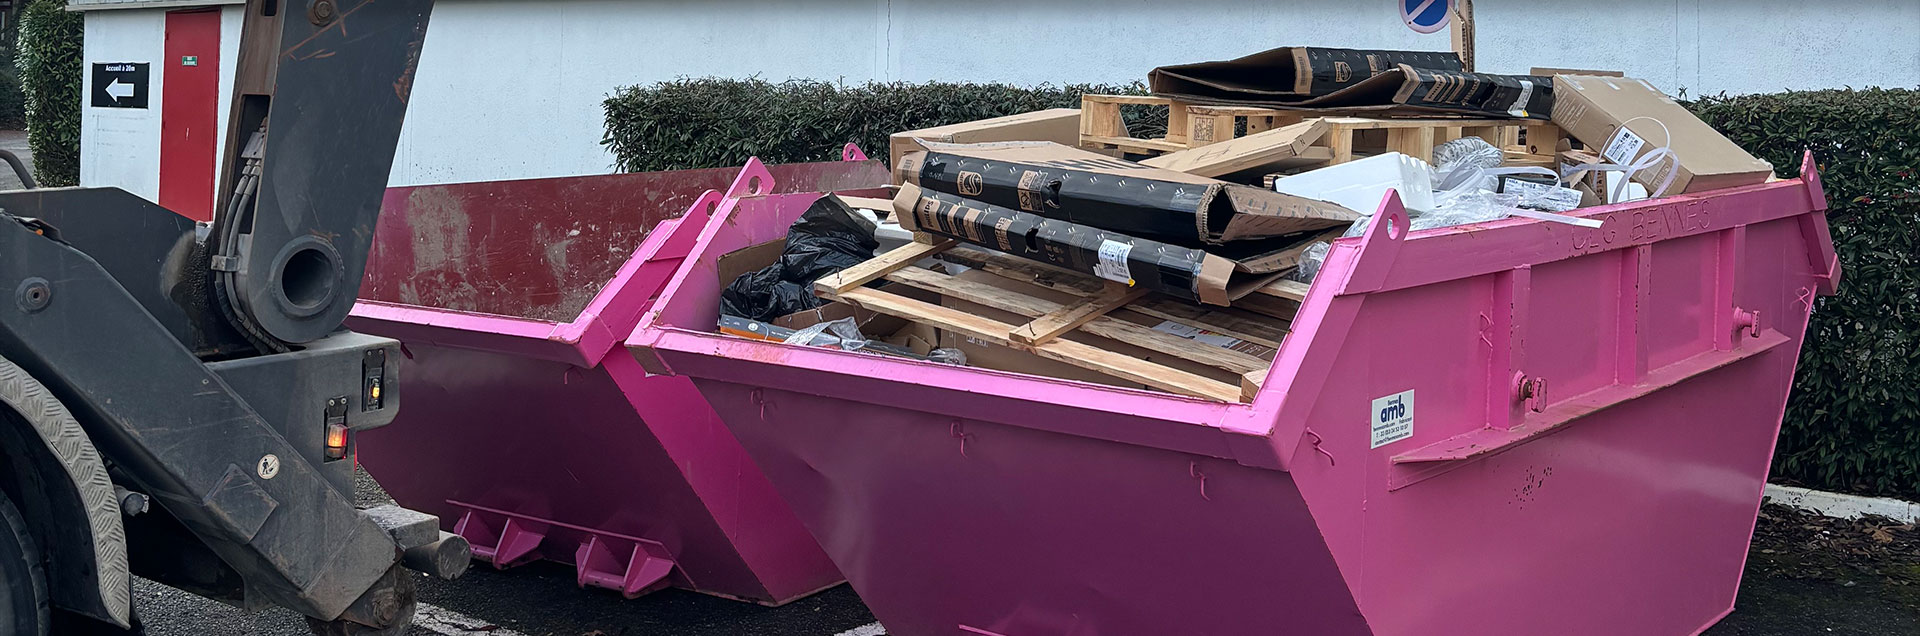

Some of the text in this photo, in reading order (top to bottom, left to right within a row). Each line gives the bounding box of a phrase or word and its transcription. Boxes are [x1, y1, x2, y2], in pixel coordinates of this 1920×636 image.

[105, 64, 121, 72] Accueil
[126, 64, 136, 72] 20m
[924, 200, 934, 228] PHILIPS
[1630, 199, 1710, 241] BENNES
[1380, 394, 1405, 423] amb
